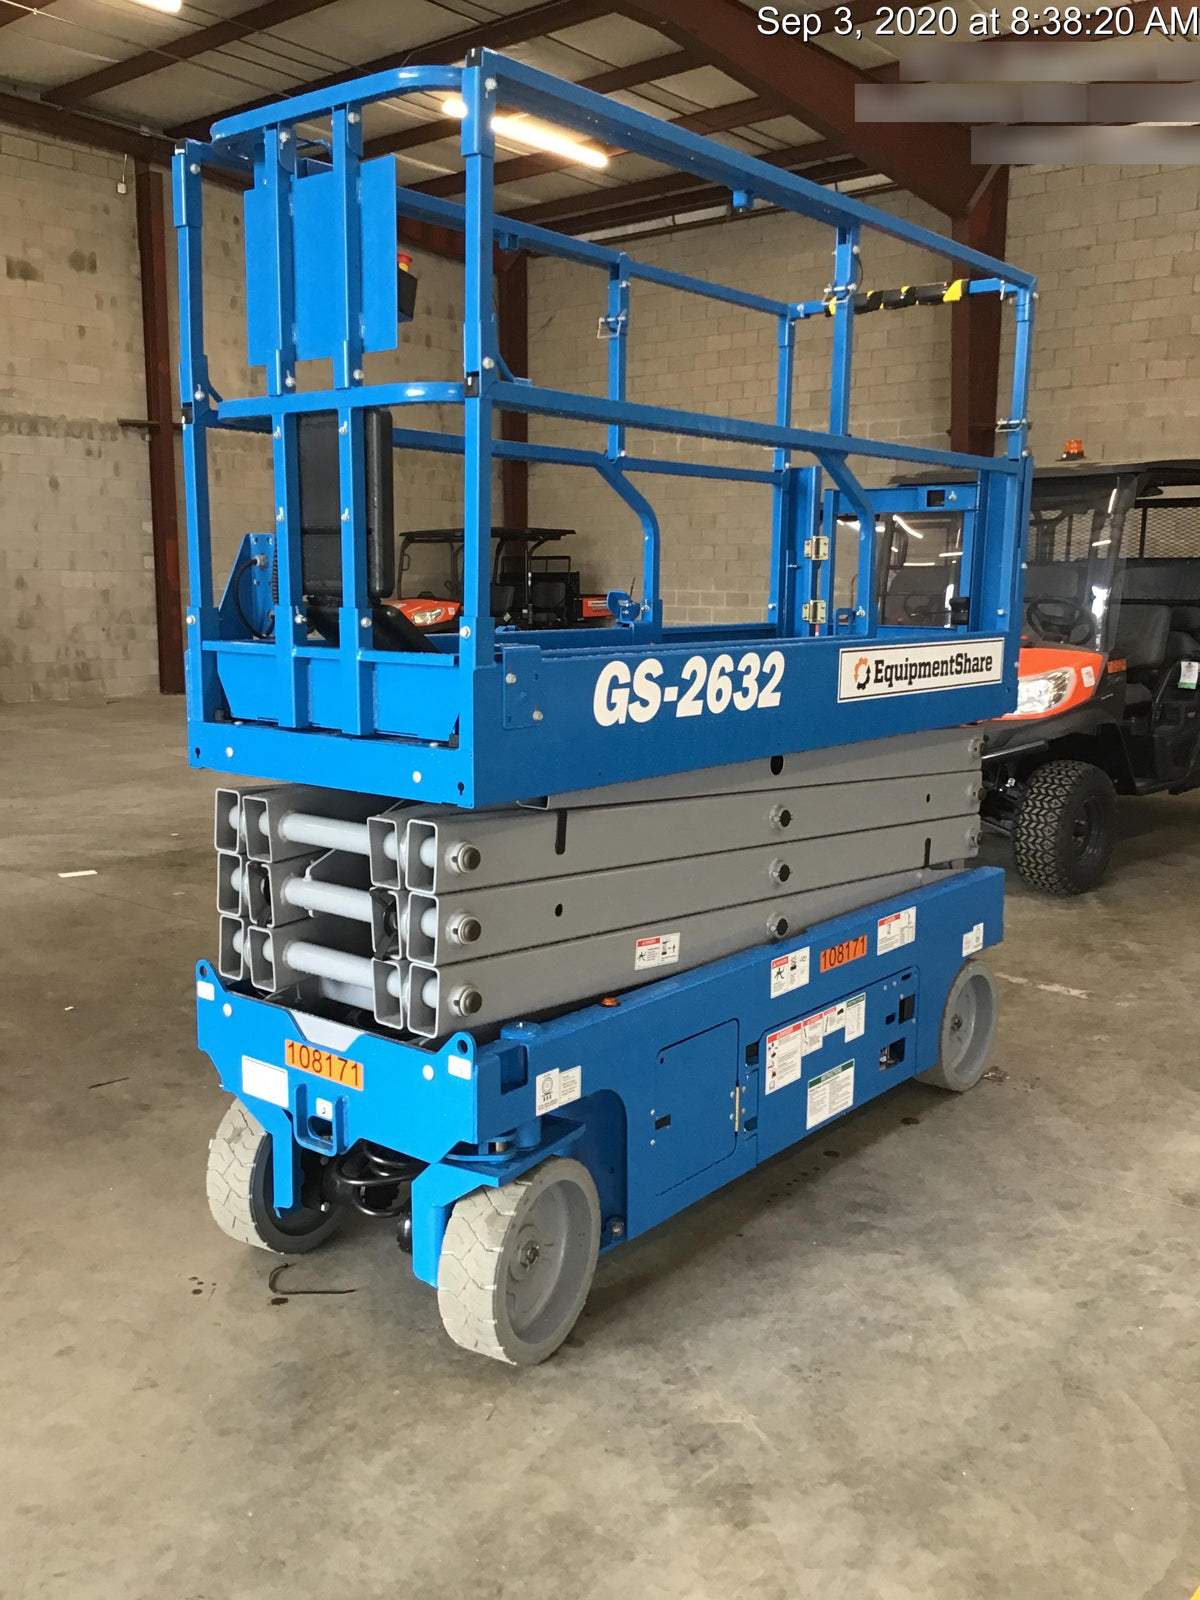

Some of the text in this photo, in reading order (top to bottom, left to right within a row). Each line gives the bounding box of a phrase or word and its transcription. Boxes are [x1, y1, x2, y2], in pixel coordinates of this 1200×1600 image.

[593, 650, 786, 727] GS-2632
[873, 652, 993, 688] EquipmentShare
[821, 937, 867, 969] 108171
[288, 1041, 359, 1087] 108171
